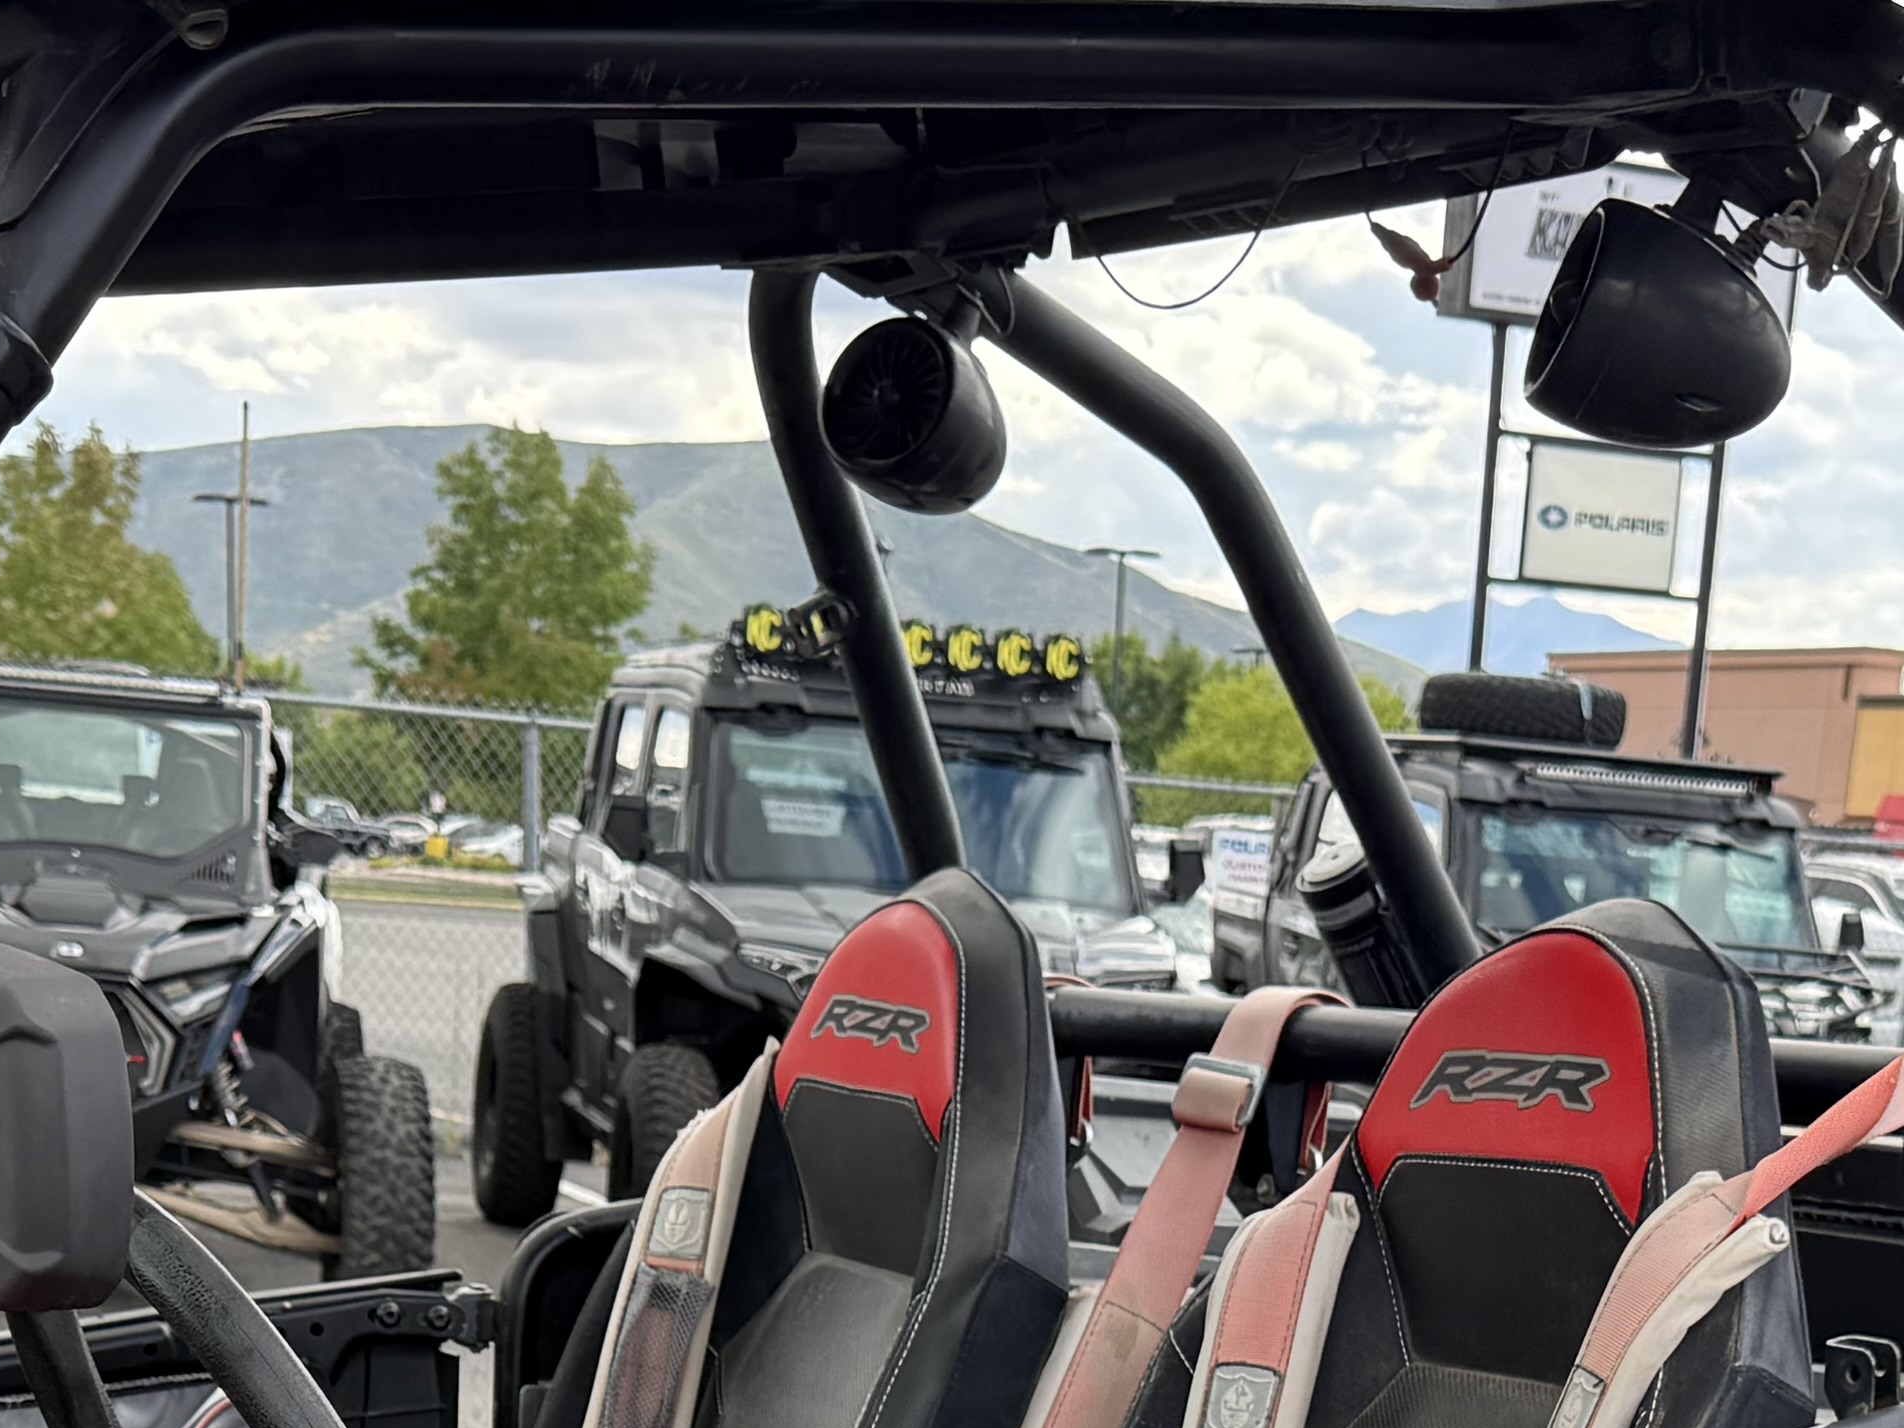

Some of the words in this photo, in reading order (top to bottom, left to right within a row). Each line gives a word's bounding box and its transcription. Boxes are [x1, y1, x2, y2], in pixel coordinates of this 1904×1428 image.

[1574, 510, 1669, 537] POLARIS
[811, 994, 932, 1055] RZR
[1410, 1050, 1612, 1112] RZR
